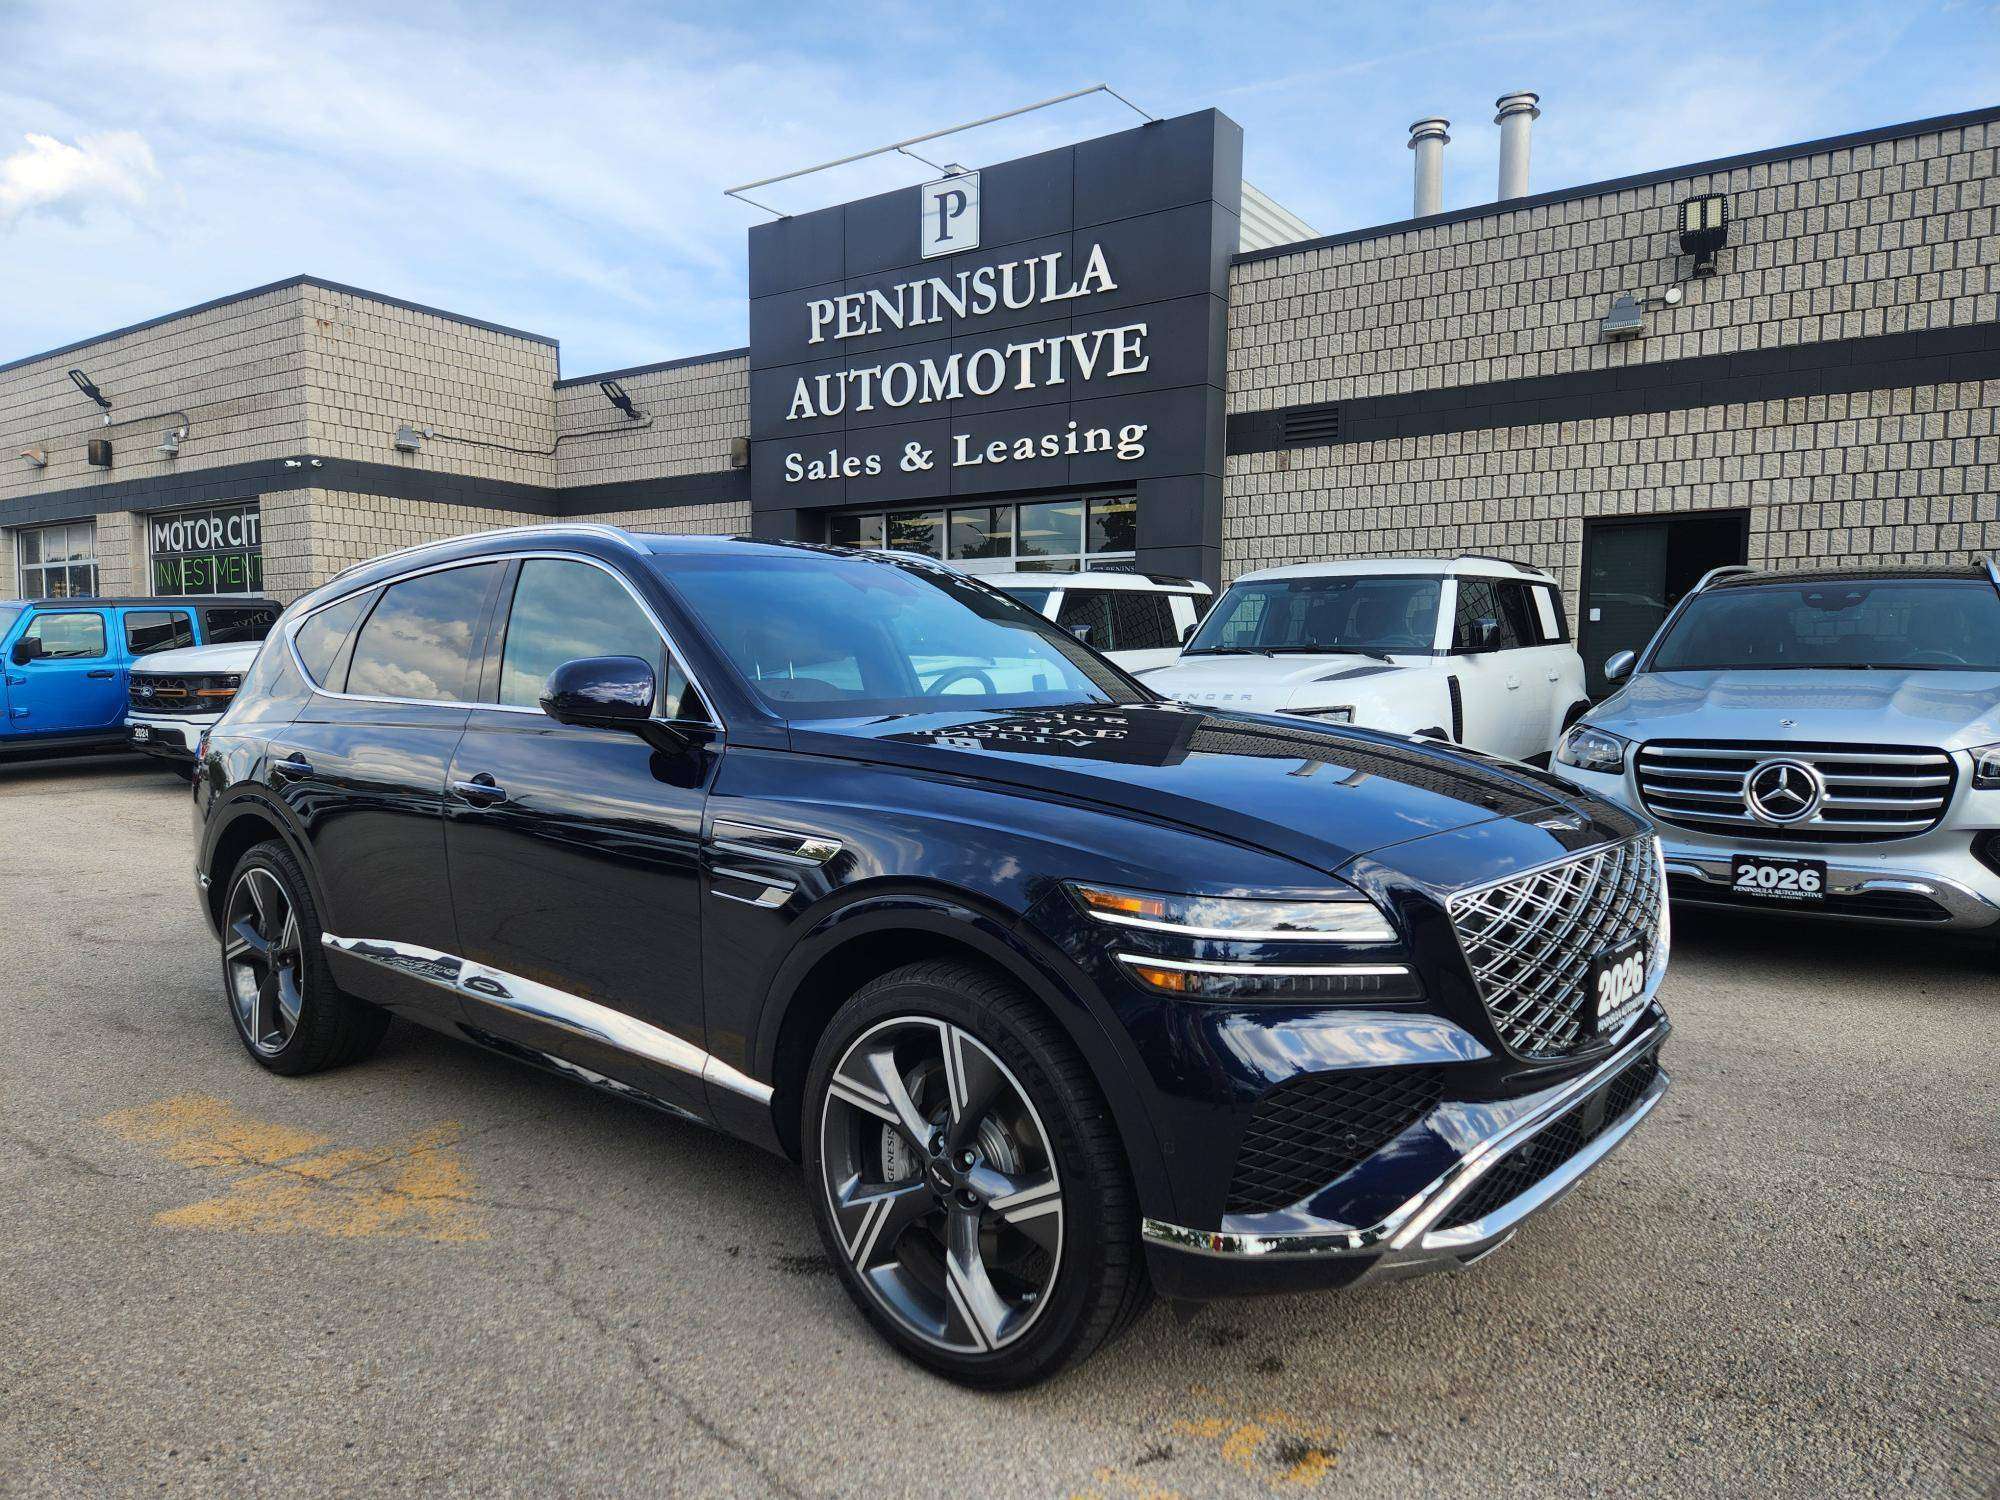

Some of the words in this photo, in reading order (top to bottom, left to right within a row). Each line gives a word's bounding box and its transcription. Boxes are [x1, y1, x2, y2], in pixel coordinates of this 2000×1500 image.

[933, 189, 967, 243] P
[807, 243, 1118, 344] PENINSULA
[785, 323, 1150, 421] AUTOMOTIVE
[785, 449, 882, 483] Sales
[900, 441, 935, 472] &
[952, 421, 1149, 461] Leasing
[155, 517, 225, 552] MOTOR
[1169, 693, 1253, 701] ENDER
[1733, 885, 1773, 895] PENINSULA
[1774, 888, 1823, 899] AUTOMOTIVE
[1736, 864, 1821, 892] 2026
[1597, 951, 1644, 1018] 2026
[887, 1127, 895, 1182] GENESIS
